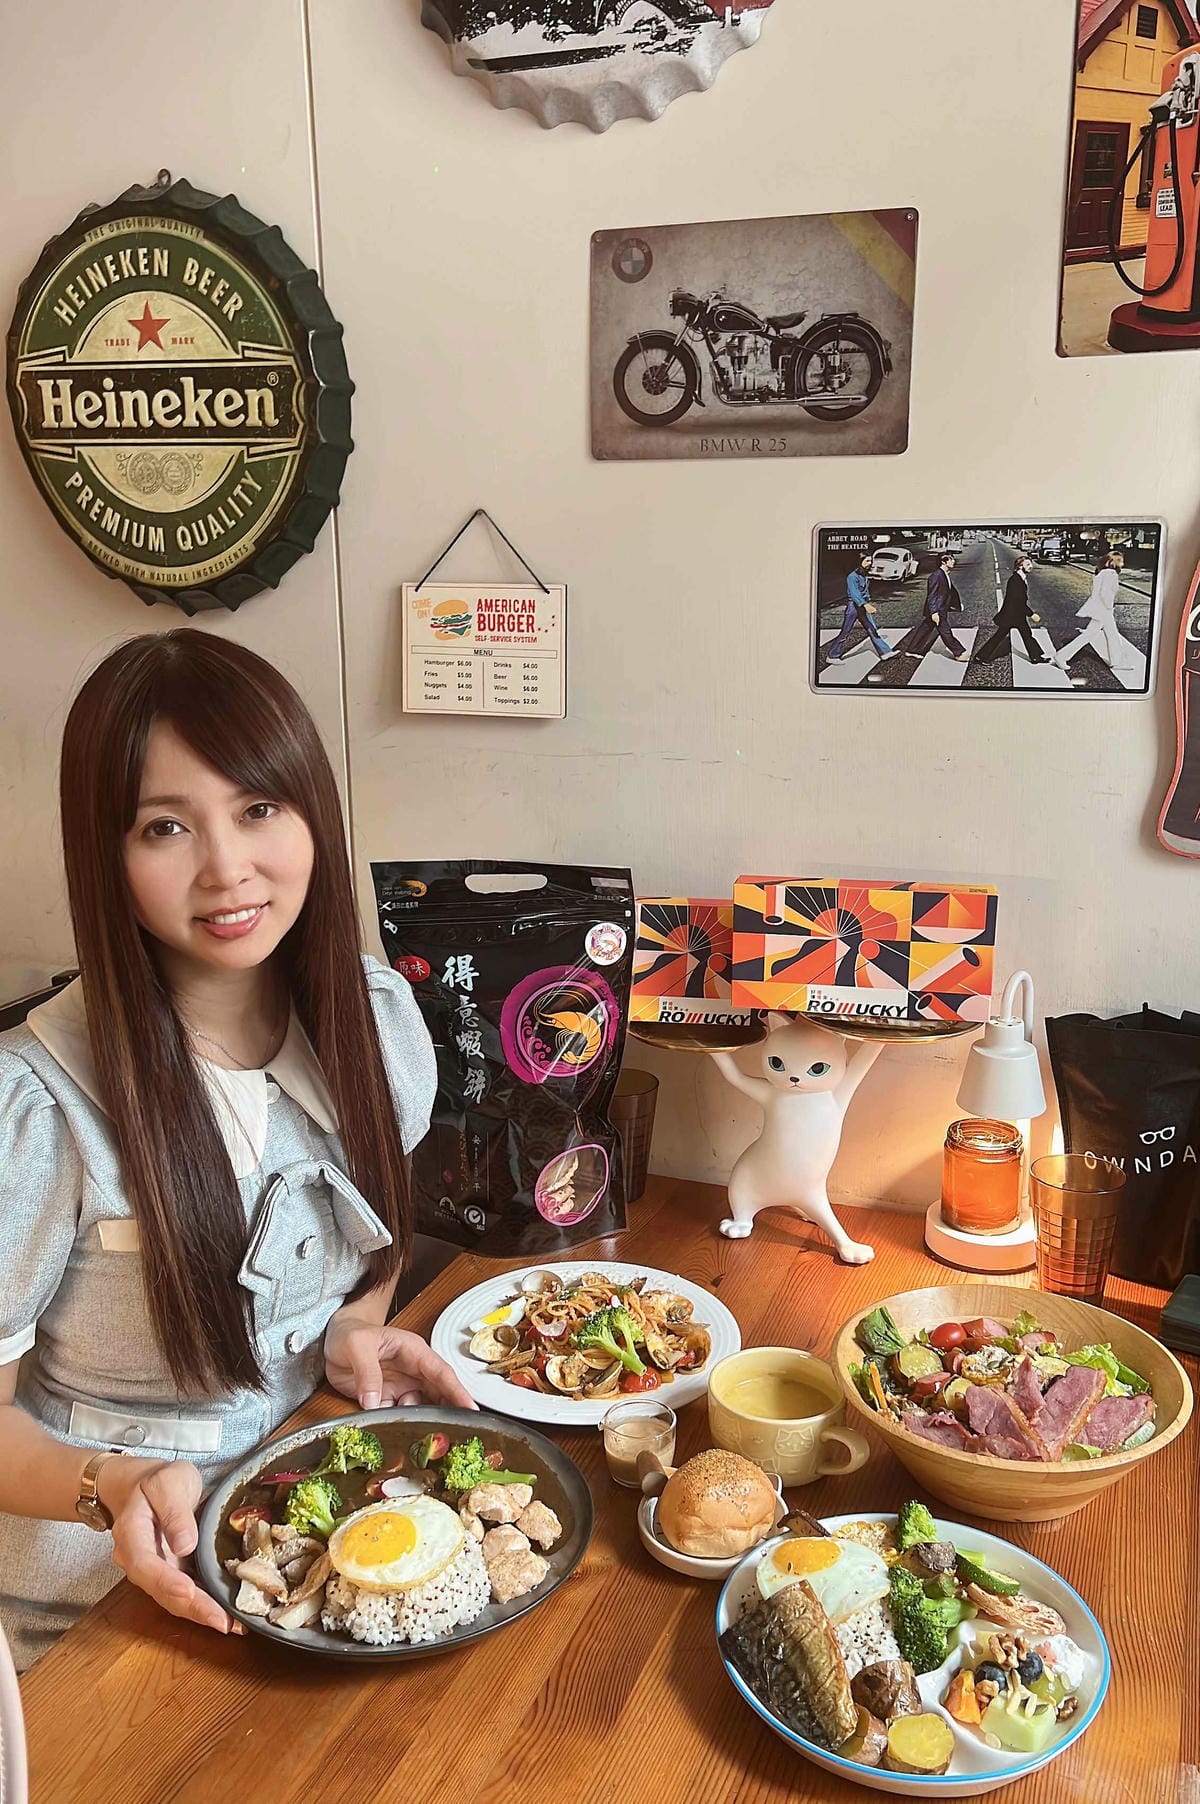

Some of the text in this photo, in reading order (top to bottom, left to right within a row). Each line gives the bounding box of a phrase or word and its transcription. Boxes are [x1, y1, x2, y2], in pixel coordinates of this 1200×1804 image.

[88, 217, 202, 242] THE ORIGINAL QUALITY
[53, 248, 244, 327] HEINEKEN BEER
[105, 337, 195, 348] TRADE MARK
[37, 377, 280, 430] Heineken
[700, 438, 787, 453] BMW R 25
[65, 470, 263, 553] PREMIUM QUALITY
[123, 563, 146, 579] WITH
[149, 571, 188, 583] NATURAL
[191, 544, 249, 581] INGREDIENTS
[476, 598, 536, 614] AMERICAN
[477, 614, 536, 633] BURGER
[474, 635, 538, 644] SELF-SERVICE SYSTEM
[473, 649, 493, 657] MENU
[424, 660, 455, 668] Hamburger
[424, 682, 447, 690] Nuggets
[494, 697, 520, 705] Toppings
